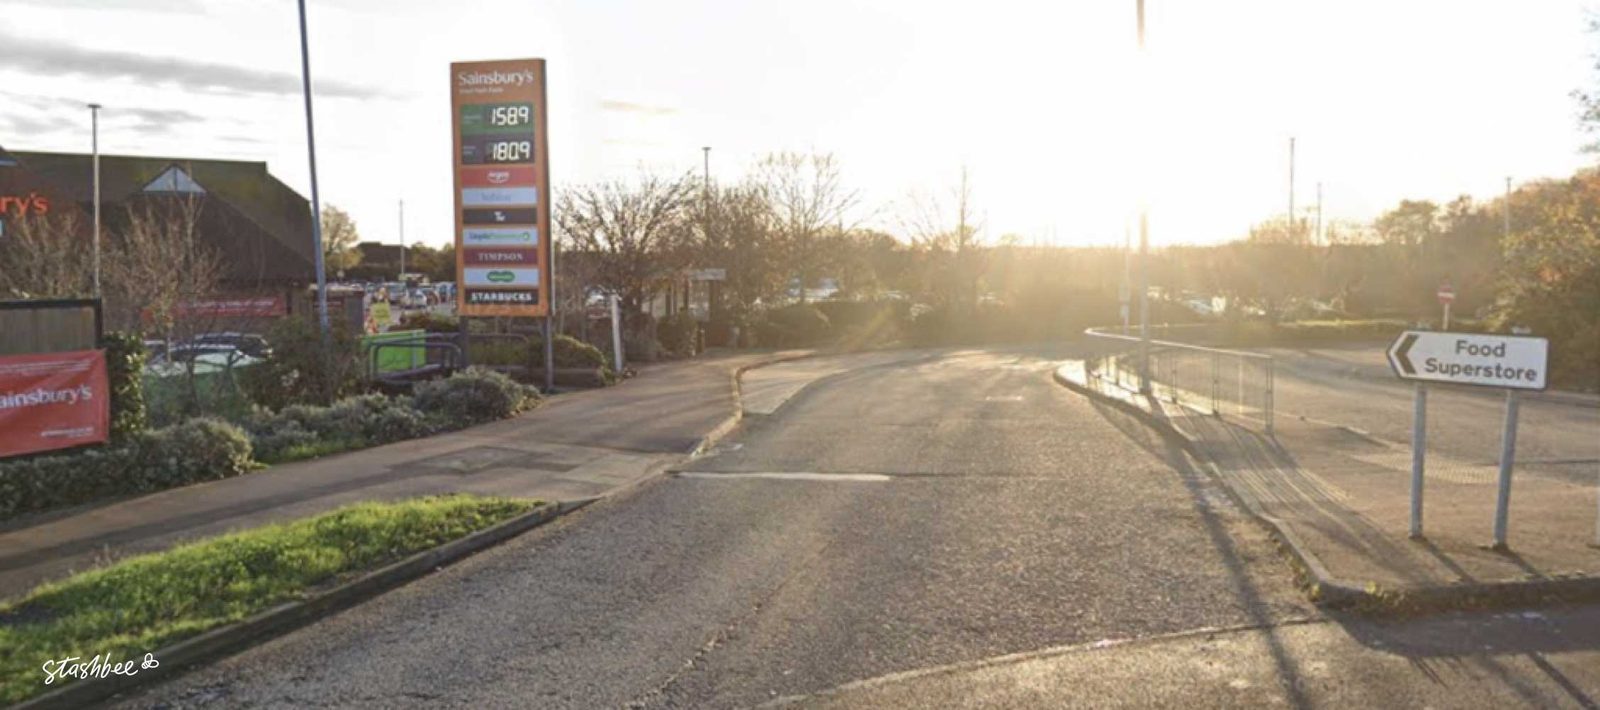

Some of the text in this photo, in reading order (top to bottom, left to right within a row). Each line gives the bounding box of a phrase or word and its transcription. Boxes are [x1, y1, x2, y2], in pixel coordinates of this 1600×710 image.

[458, 69, 534, 87] Sainsbury's
[477, 253, 523, 261] TIMPSON
[471, 292, 532, 301] STARBUCKS
[1455, 339, 1506, 357] Food
[1425, 357, 1537, 381] Superstore
